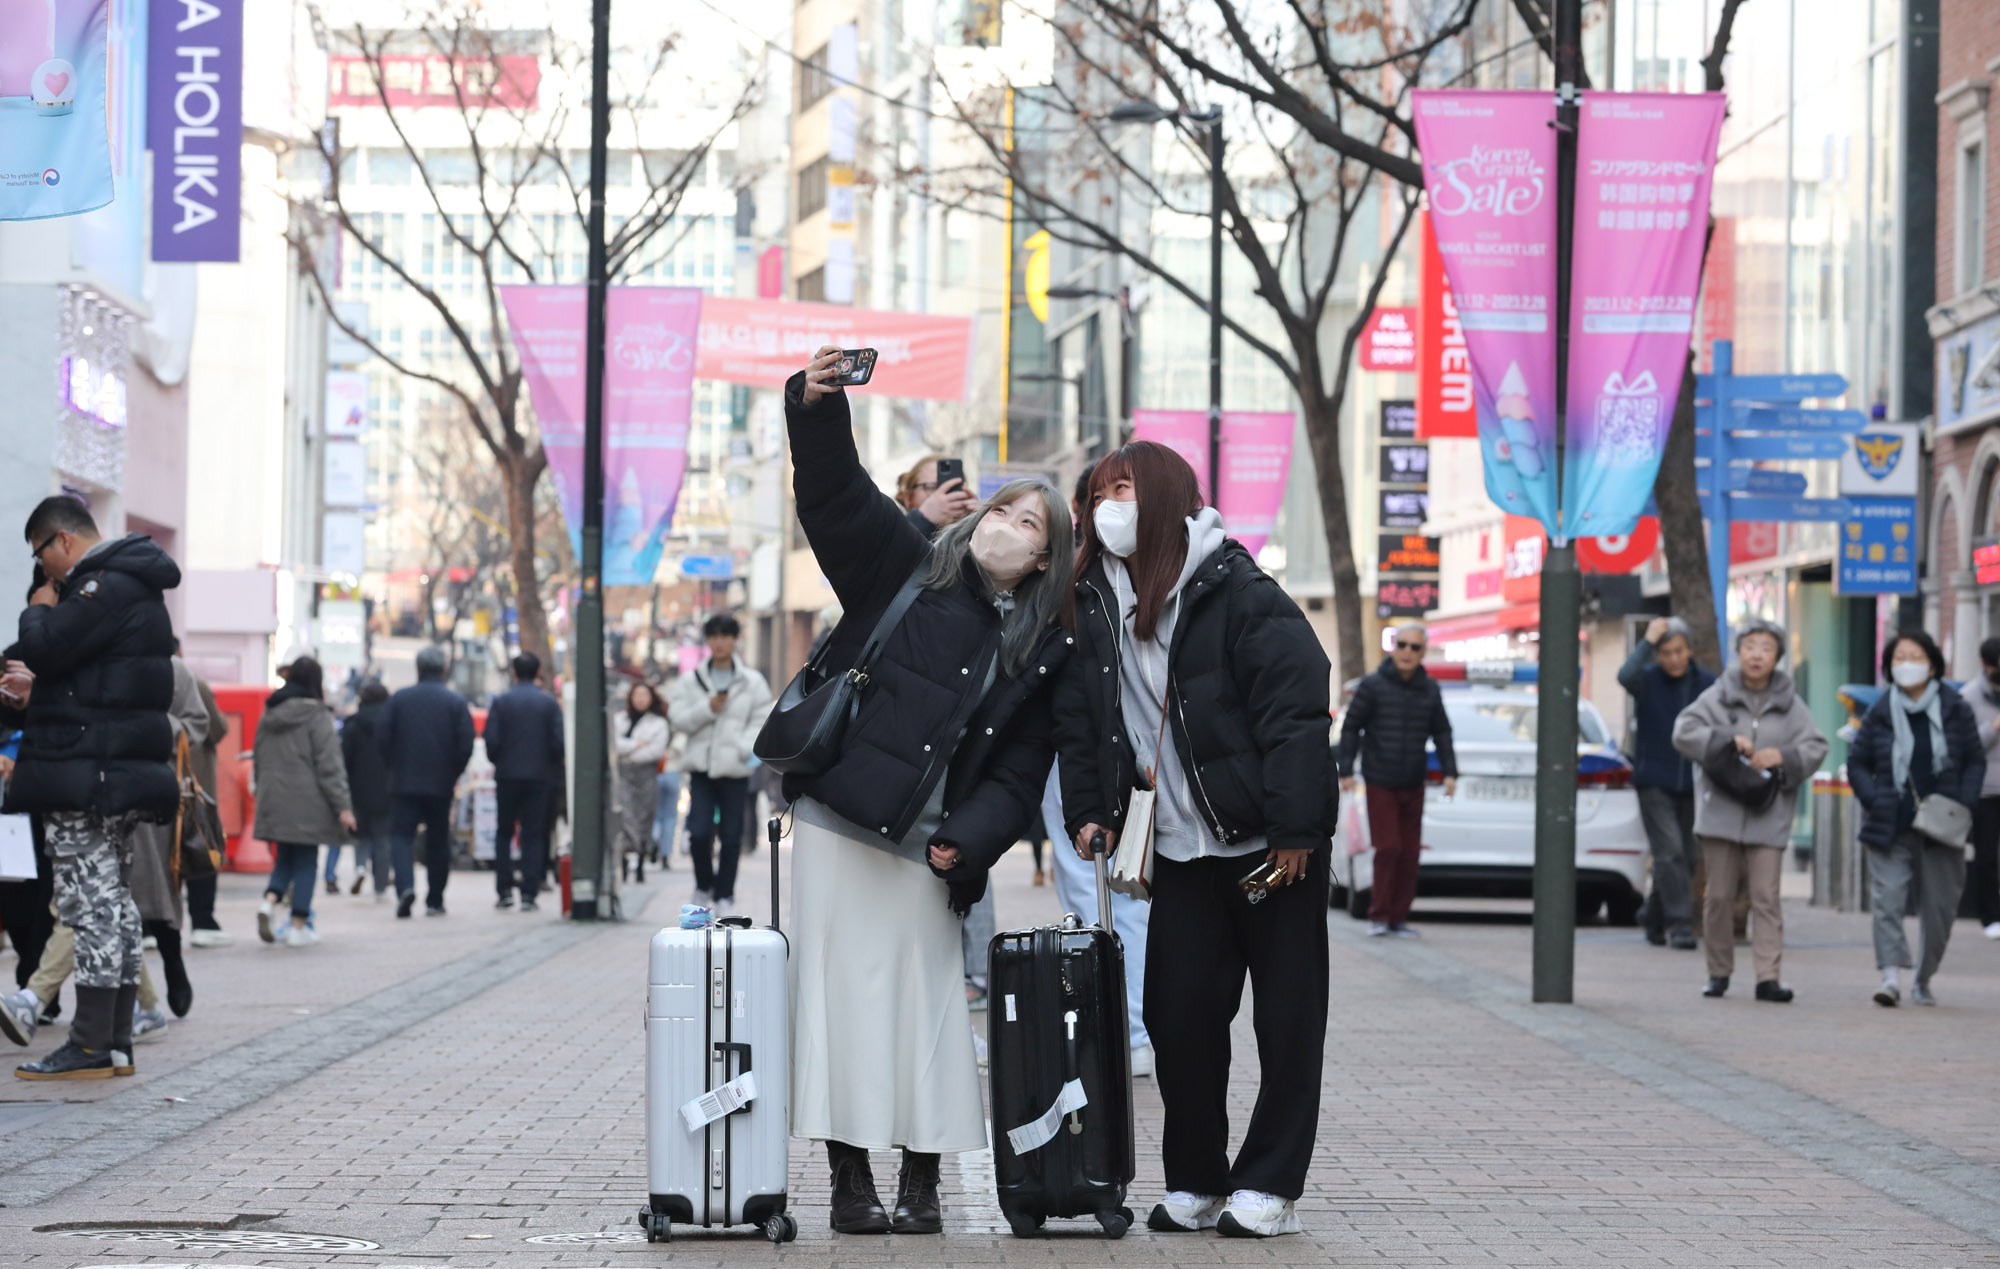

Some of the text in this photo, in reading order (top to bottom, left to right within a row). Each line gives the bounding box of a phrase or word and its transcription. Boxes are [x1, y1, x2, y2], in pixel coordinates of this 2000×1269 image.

[172, 46, 221, 234] HOLIKA
[1472, 144, 1530, 164] Korea
[1473, 157, 1536, 177] Grand
[1590, 160, 1707, 177] コリアグランドセール
[1431, 157, 1545, 217] Sale
[1474, 243, 1519, 256] BUCKET
[1522, 243, 1546, 256] LIST
[1379, 313, 1407, 330] ALL
[1371, 330, 1413, 346] MASK
[1370, 347, 1415, 364] STORY
